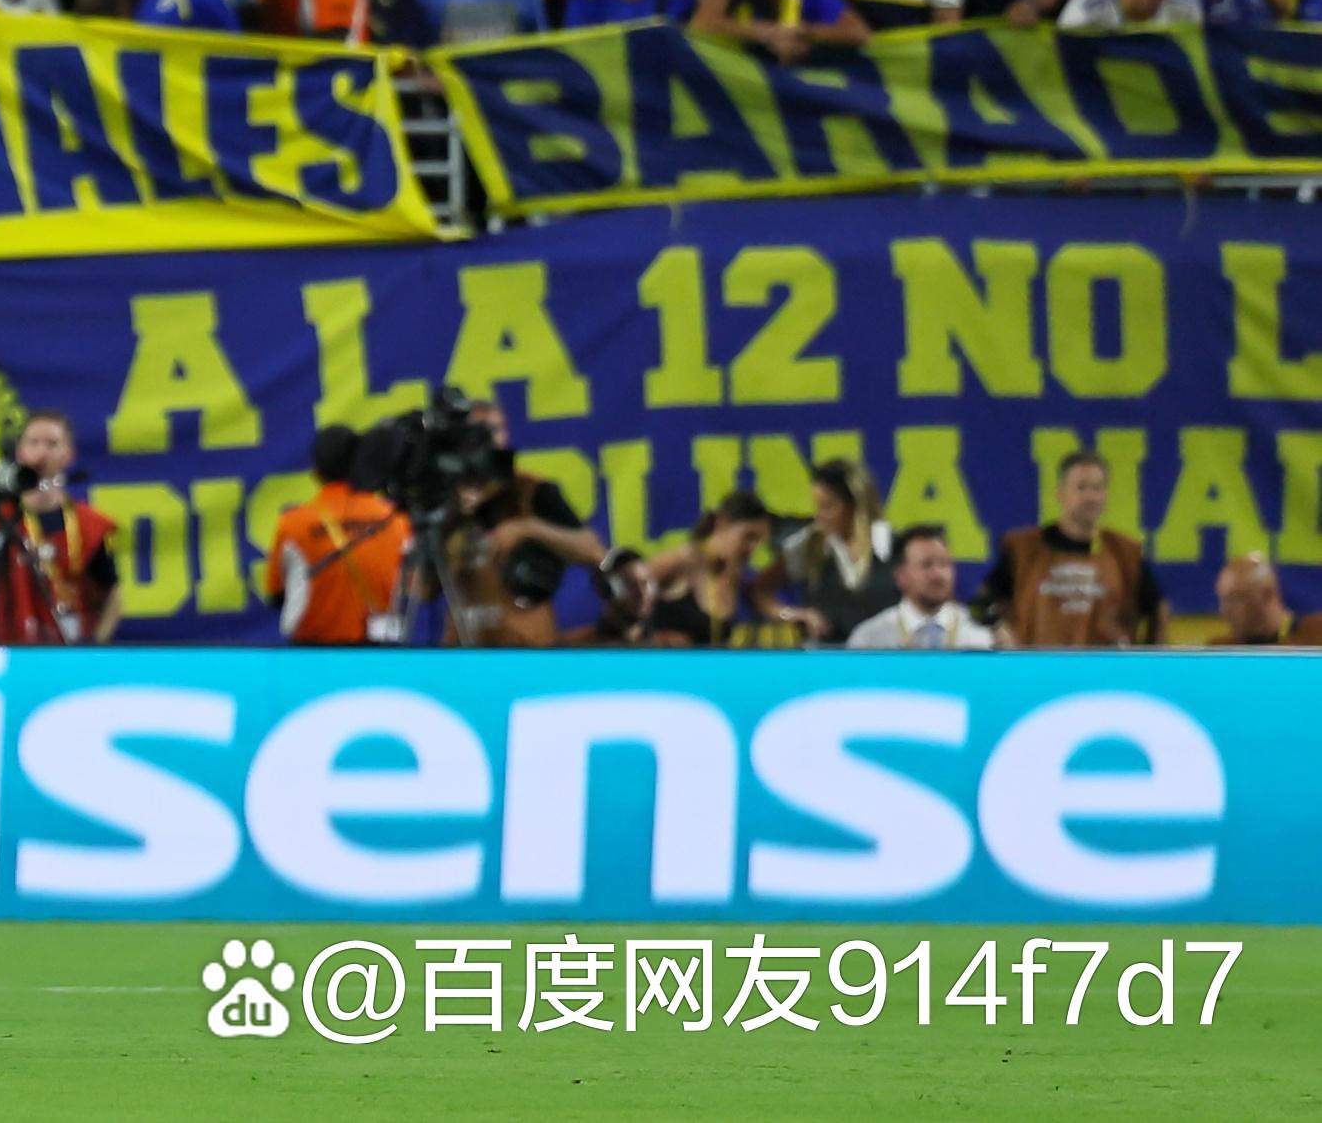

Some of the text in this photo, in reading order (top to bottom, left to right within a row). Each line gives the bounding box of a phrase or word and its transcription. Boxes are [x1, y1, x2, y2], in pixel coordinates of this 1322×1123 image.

[108, 292, 262, 454] A
[302, 260, 592, 432] LA
[637, 244, 843, 409] 12
[890, 236, 1167, 399] NO
